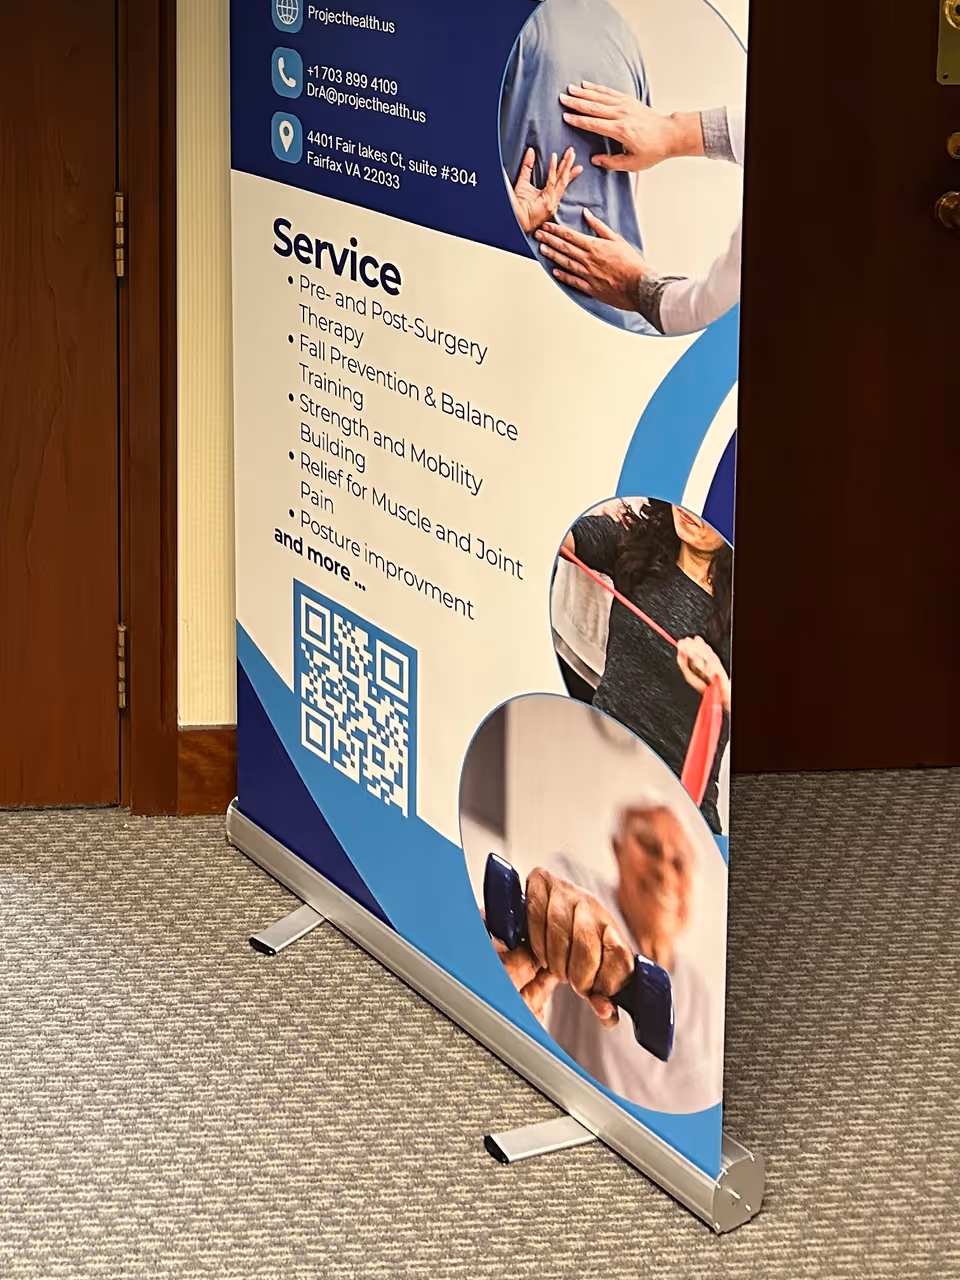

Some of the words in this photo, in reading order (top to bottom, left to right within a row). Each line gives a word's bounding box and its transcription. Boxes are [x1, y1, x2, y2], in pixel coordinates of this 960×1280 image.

[308, 5, 395, 33] Projecthealth.us
[307, 82, 426, 123] DrA@projecthealth.us
[320, 66, 343, 83] 703
[345, 71, 368, 89] 899
[370, 76, 398, 96] 4109
[307, 130, 333, 148] 4401
[335, 137, 356, 154] Fair
[358, 142, 388, 164] lakes
[390, 151, 406, 171] Ct,
[408, 159, 438, 178] suite
[440, 165, 478, 187] #304
[307, 151, 343, 174] Fairfax
[345, 160, 362, 179] VA
[363, 166, 400, 190] 22033
[273, 217, 402, 296] Service
[299, 303, 364, 349] Therapy
[300, 274, 331, 300] Pre-
[335, 291, 367, 316] and
[371, 301, 489, 365] Post-Surgery
[299, 362, 364, 411] Training
[300, 333, 326, 362] Fall
[330, 346, 420, 401] Prevention
[424, 386, 437, 408] &
[441, 392, 519, 442] Balance
[300, 393, 369, 441] Strength
[373, 429, 406, 458] and
[411, 443, 483, 496] Mobility
[300, 422, 366, 474] Building
[300, 481, 335, 515] Pain
[300, 452, 345, 488] Relief
[346, 474, 368, 500] for
[372, 487, 432, 533] Muscle
[435, 522, 472, 554] and
[475, 538, 524, 581] Joint
[274, 527, 304, 556] and
[306, 545, 351, 582] more
[300, 510, 361, 557] Posture
[363, 542, 475, 620] improvment
